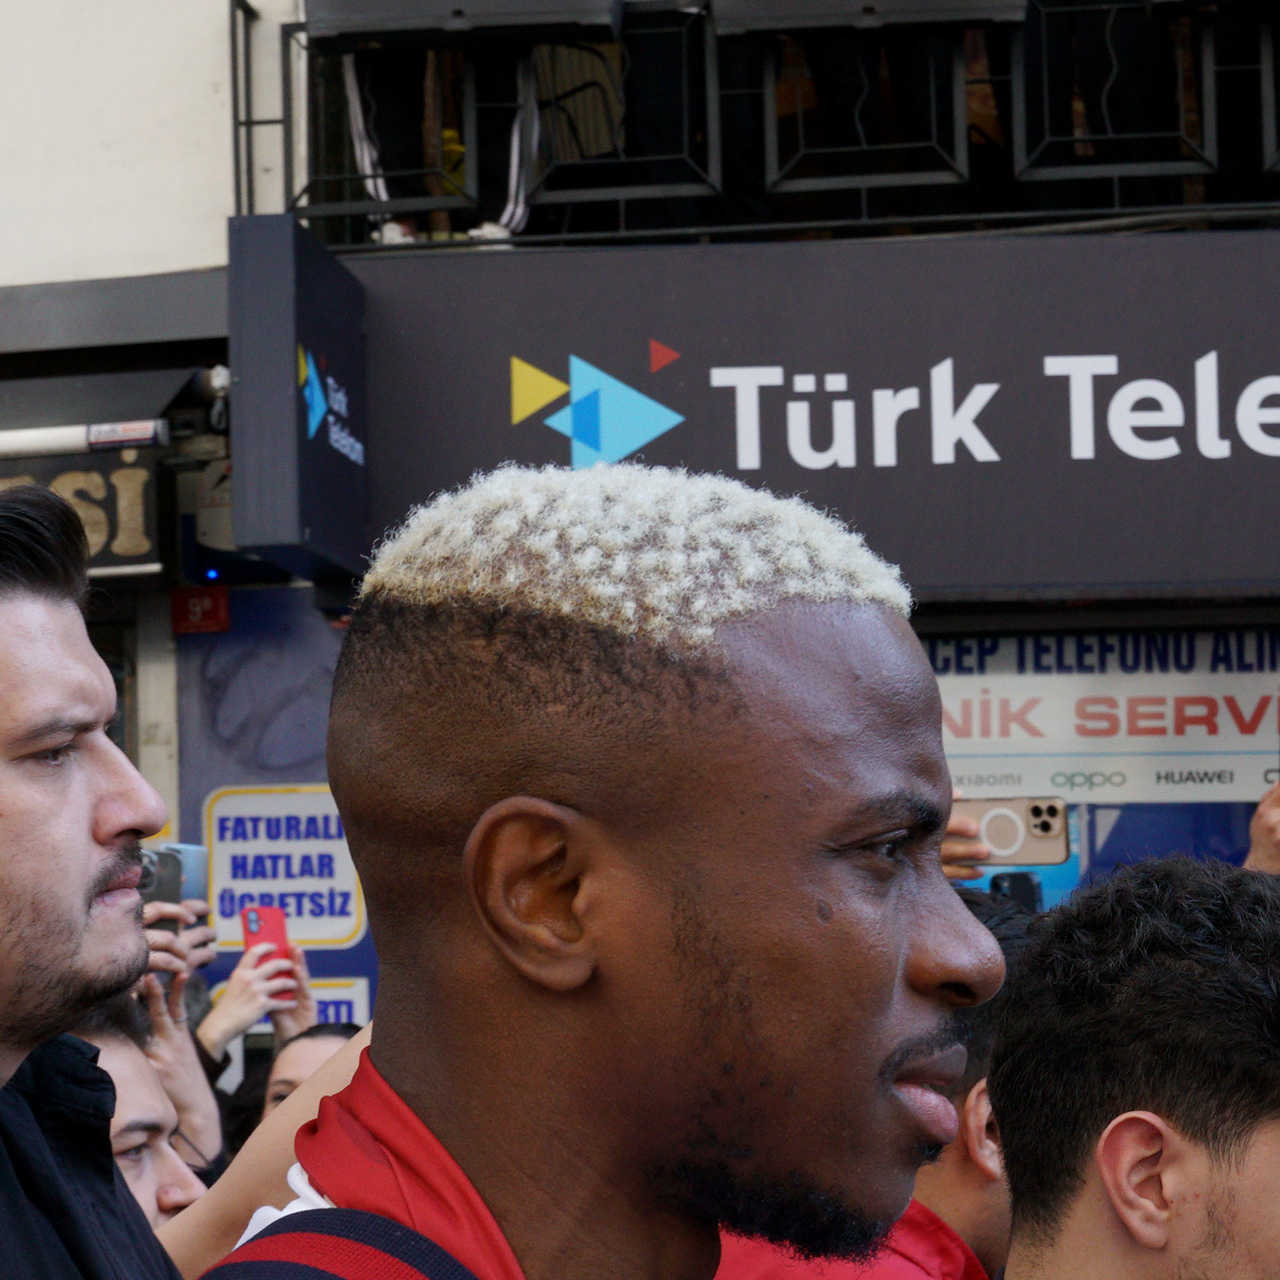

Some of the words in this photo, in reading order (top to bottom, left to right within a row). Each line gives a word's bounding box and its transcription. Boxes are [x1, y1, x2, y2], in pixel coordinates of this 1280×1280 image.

[709, 356, 1002, 471] Türk
[1050, 771, 1127, 792] oppo
[1155, 769, 1235, 785] HUAWEI
[230, 853, 335, 880] HATLAR
